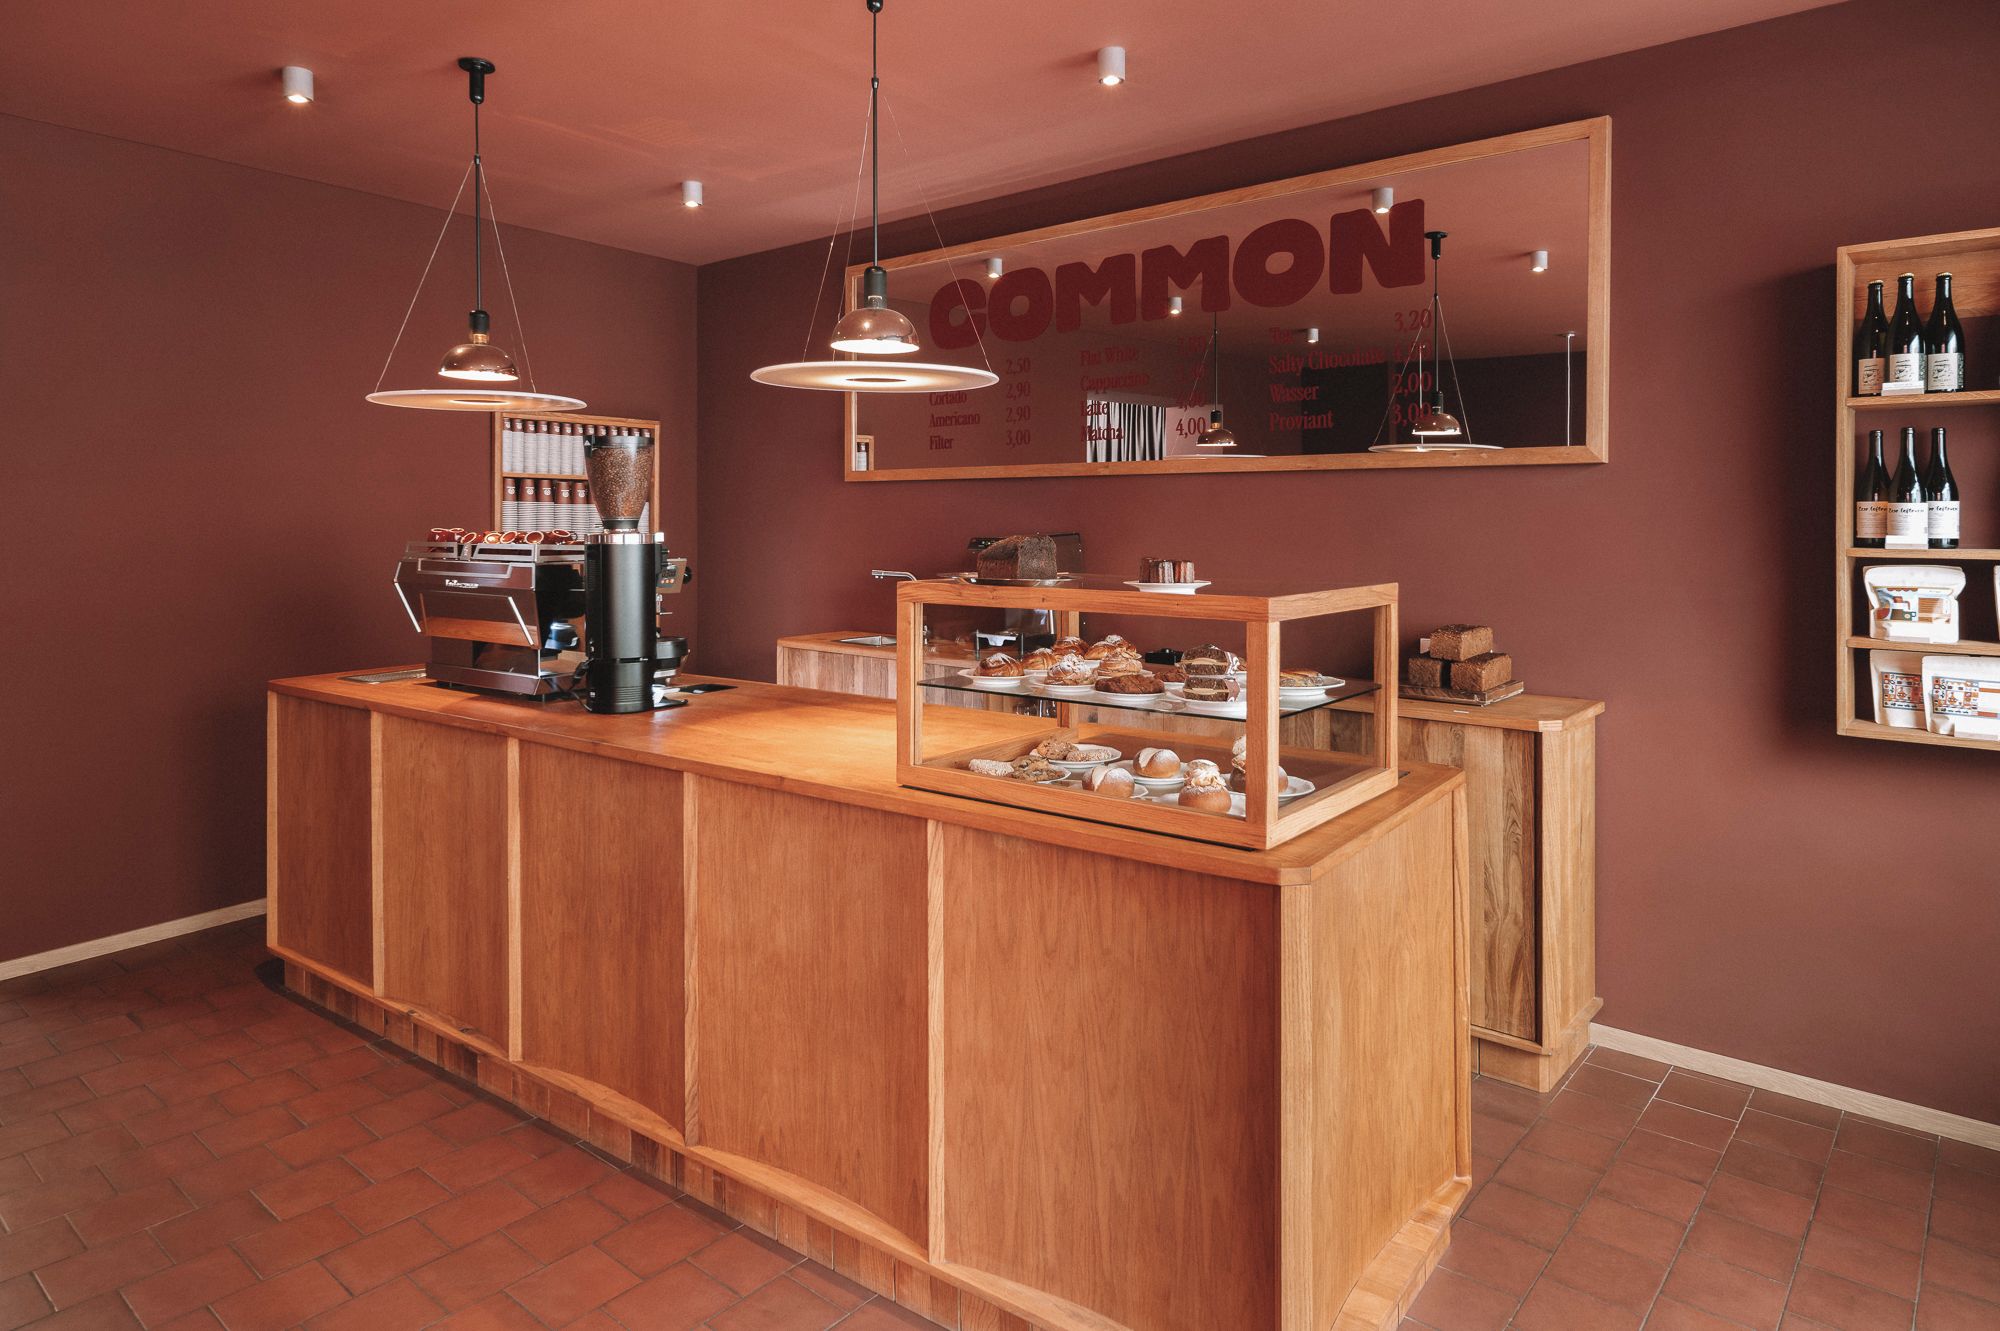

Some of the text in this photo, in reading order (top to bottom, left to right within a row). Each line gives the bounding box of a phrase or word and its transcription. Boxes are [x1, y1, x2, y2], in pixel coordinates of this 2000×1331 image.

[929, 199, 1425, 350] COMMON
[1394, 309, 1431, 332] 3,20
[1006, 358, 1030, 375] 2,50
[1269, 353, 1304, 375] Salty
[929, 382, 1030, 406] Cortado 2,90
[1081, 373, 1149, 394] Cappuccino
[1269, 371, 1431, 404] Wasser 2,00
[929, 406, 1030, 428] Americano 2,90
[1269, 410, 1334, 432] Proviant
[929, 430, 1030, 450] Filter 3,00
[1081, 417, 1206, 442] Matcha 4,00
